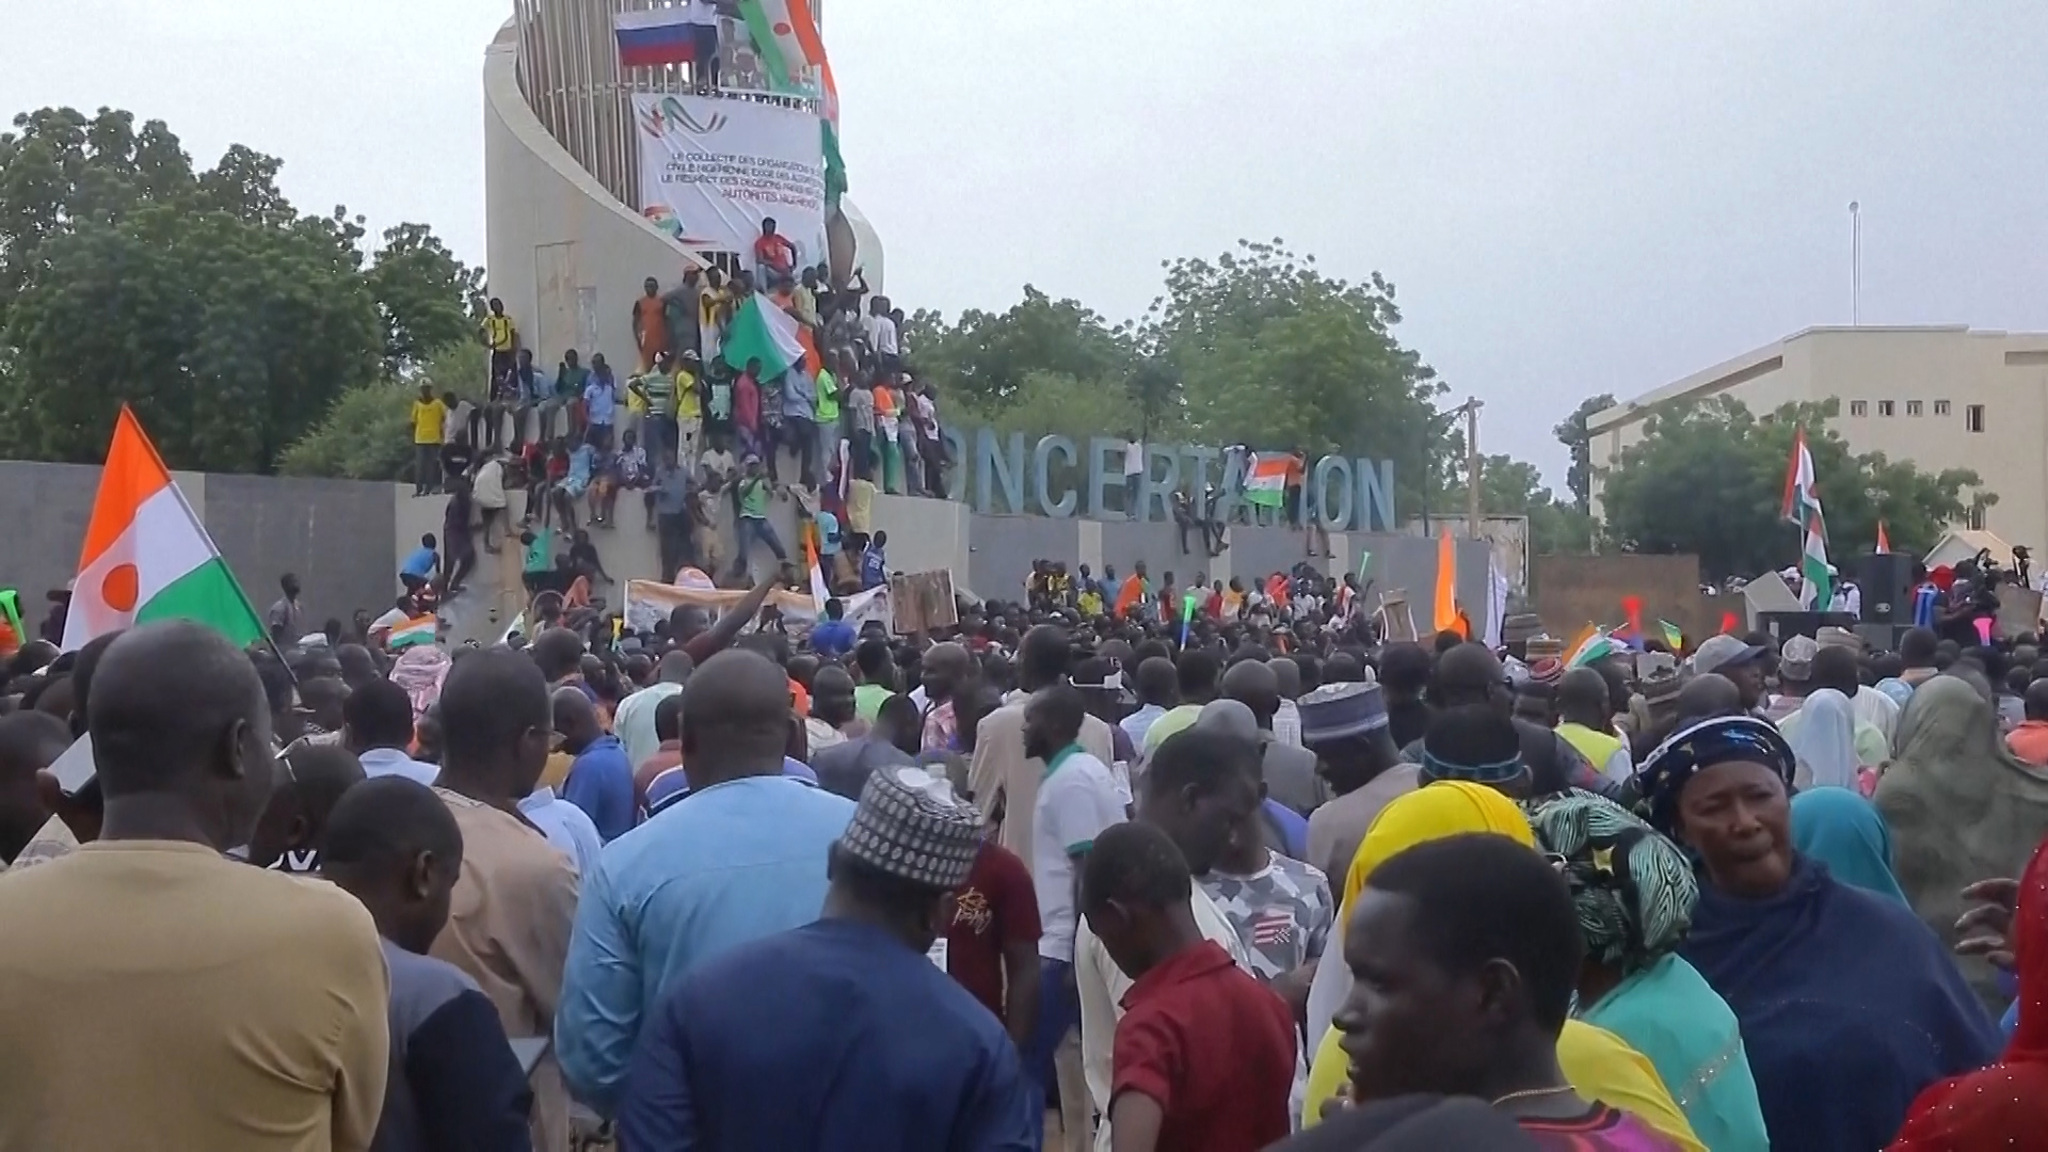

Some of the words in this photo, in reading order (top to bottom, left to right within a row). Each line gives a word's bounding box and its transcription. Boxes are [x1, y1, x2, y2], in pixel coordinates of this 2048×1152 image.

[686, 152, 737, 163] COLLECTIF
[660, 174, 674, 184] LE
[675, 174, 718, 184] RESPECT
